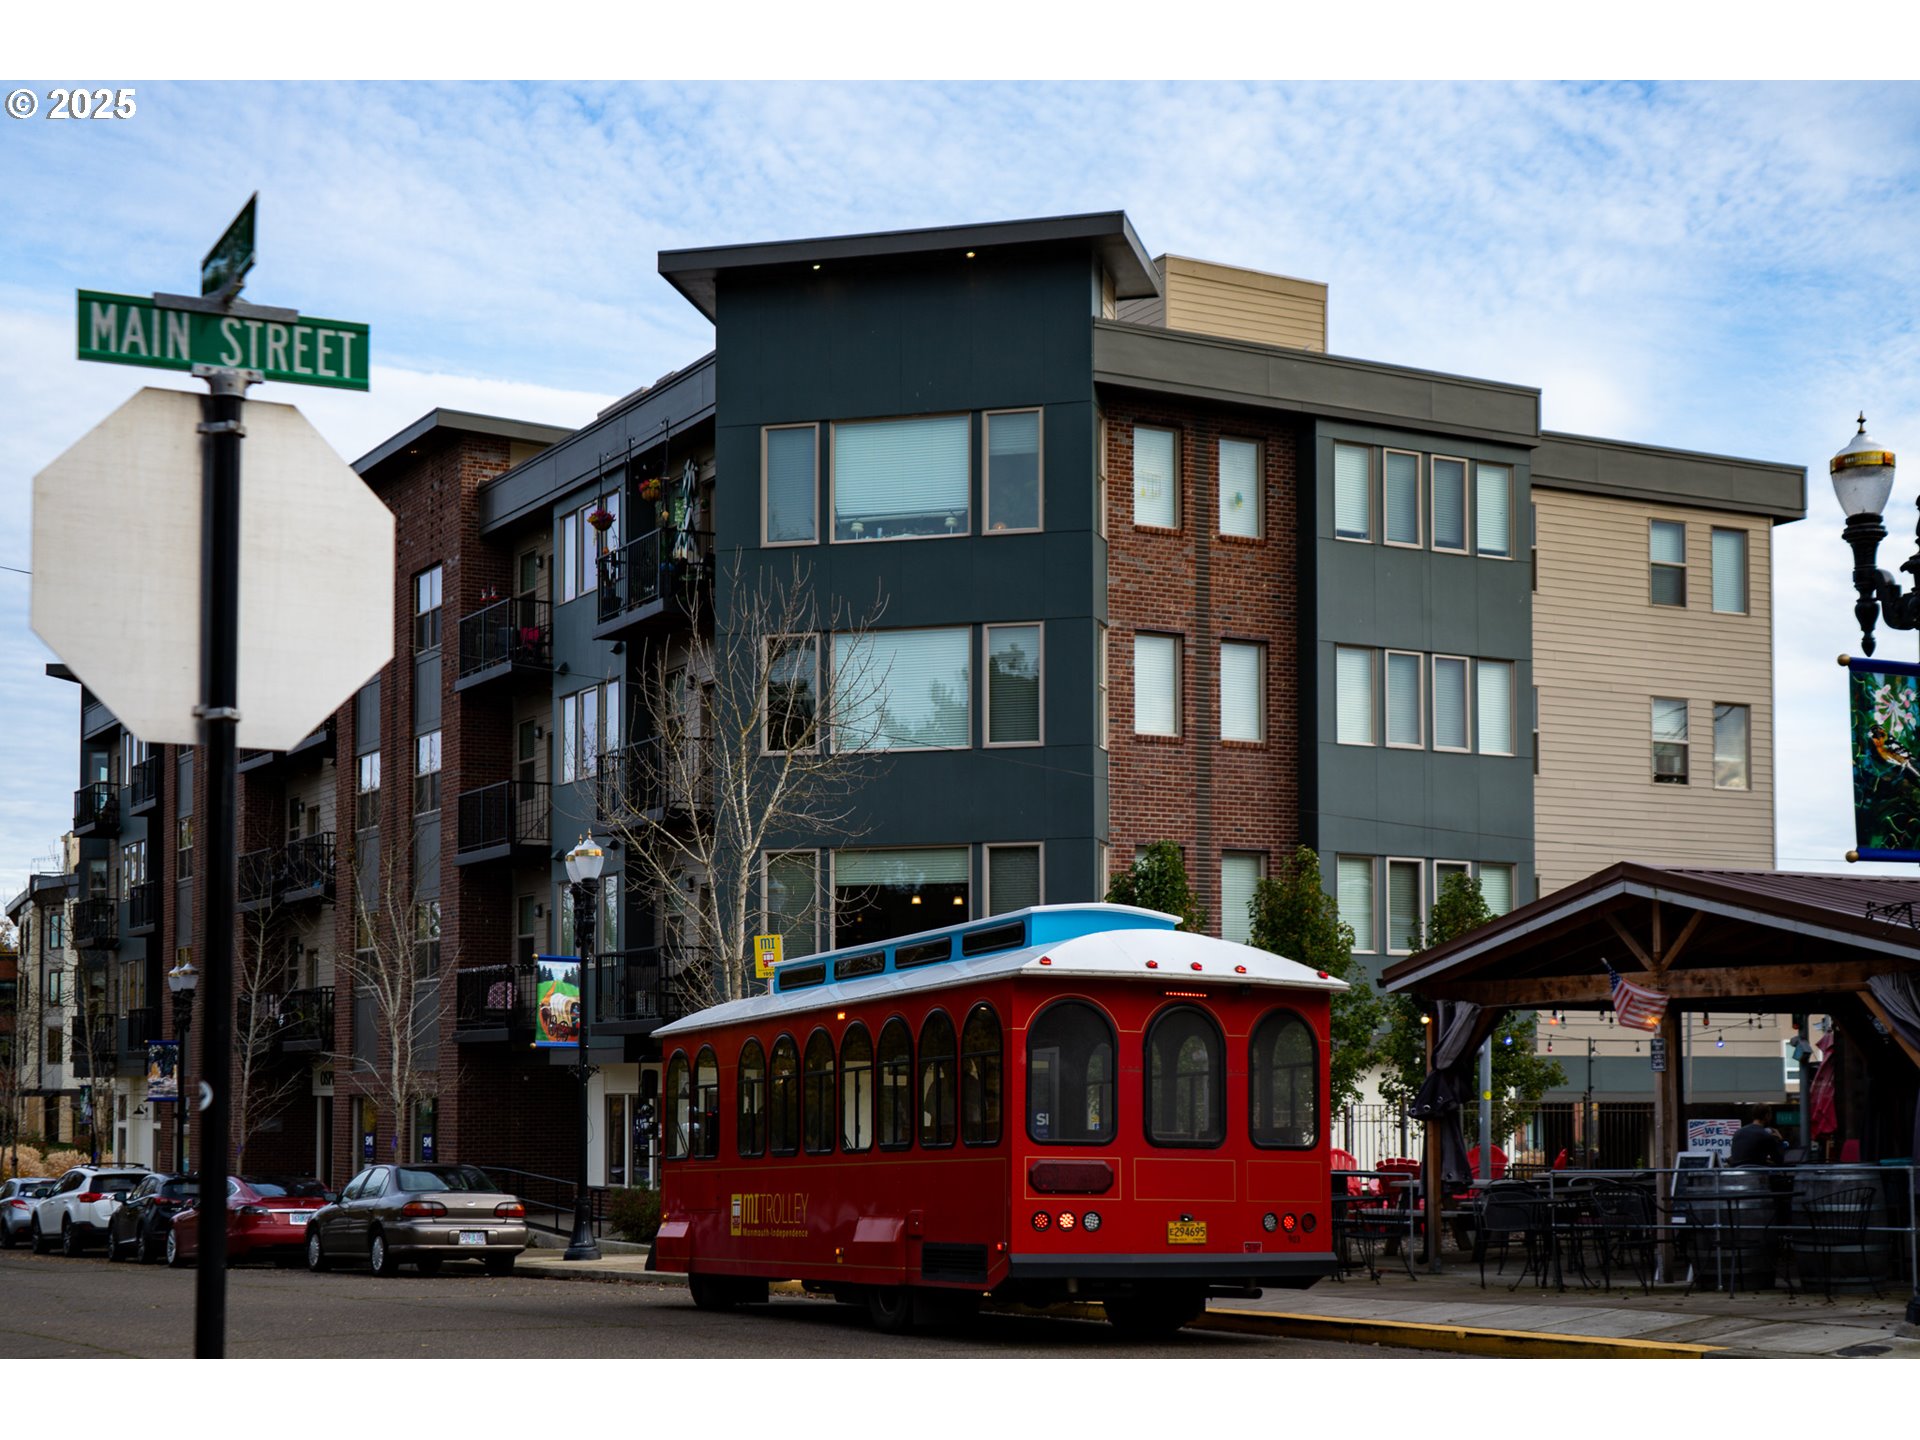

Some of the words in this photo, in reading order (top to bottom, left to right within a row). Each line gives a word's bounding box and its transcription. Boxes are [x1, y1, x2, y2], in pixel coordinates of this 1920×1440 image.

[89, 301, 190, 361] MAIN
[220, 316, 356, 379] STREET
[1704, 1127, 1723, 1135] WE
[1692, 1138, 1733, 1147] SUPPOR
[760, 1192, 809, 1225] TROLLEY
[1169, 1226, 1206, 1237] E294695
